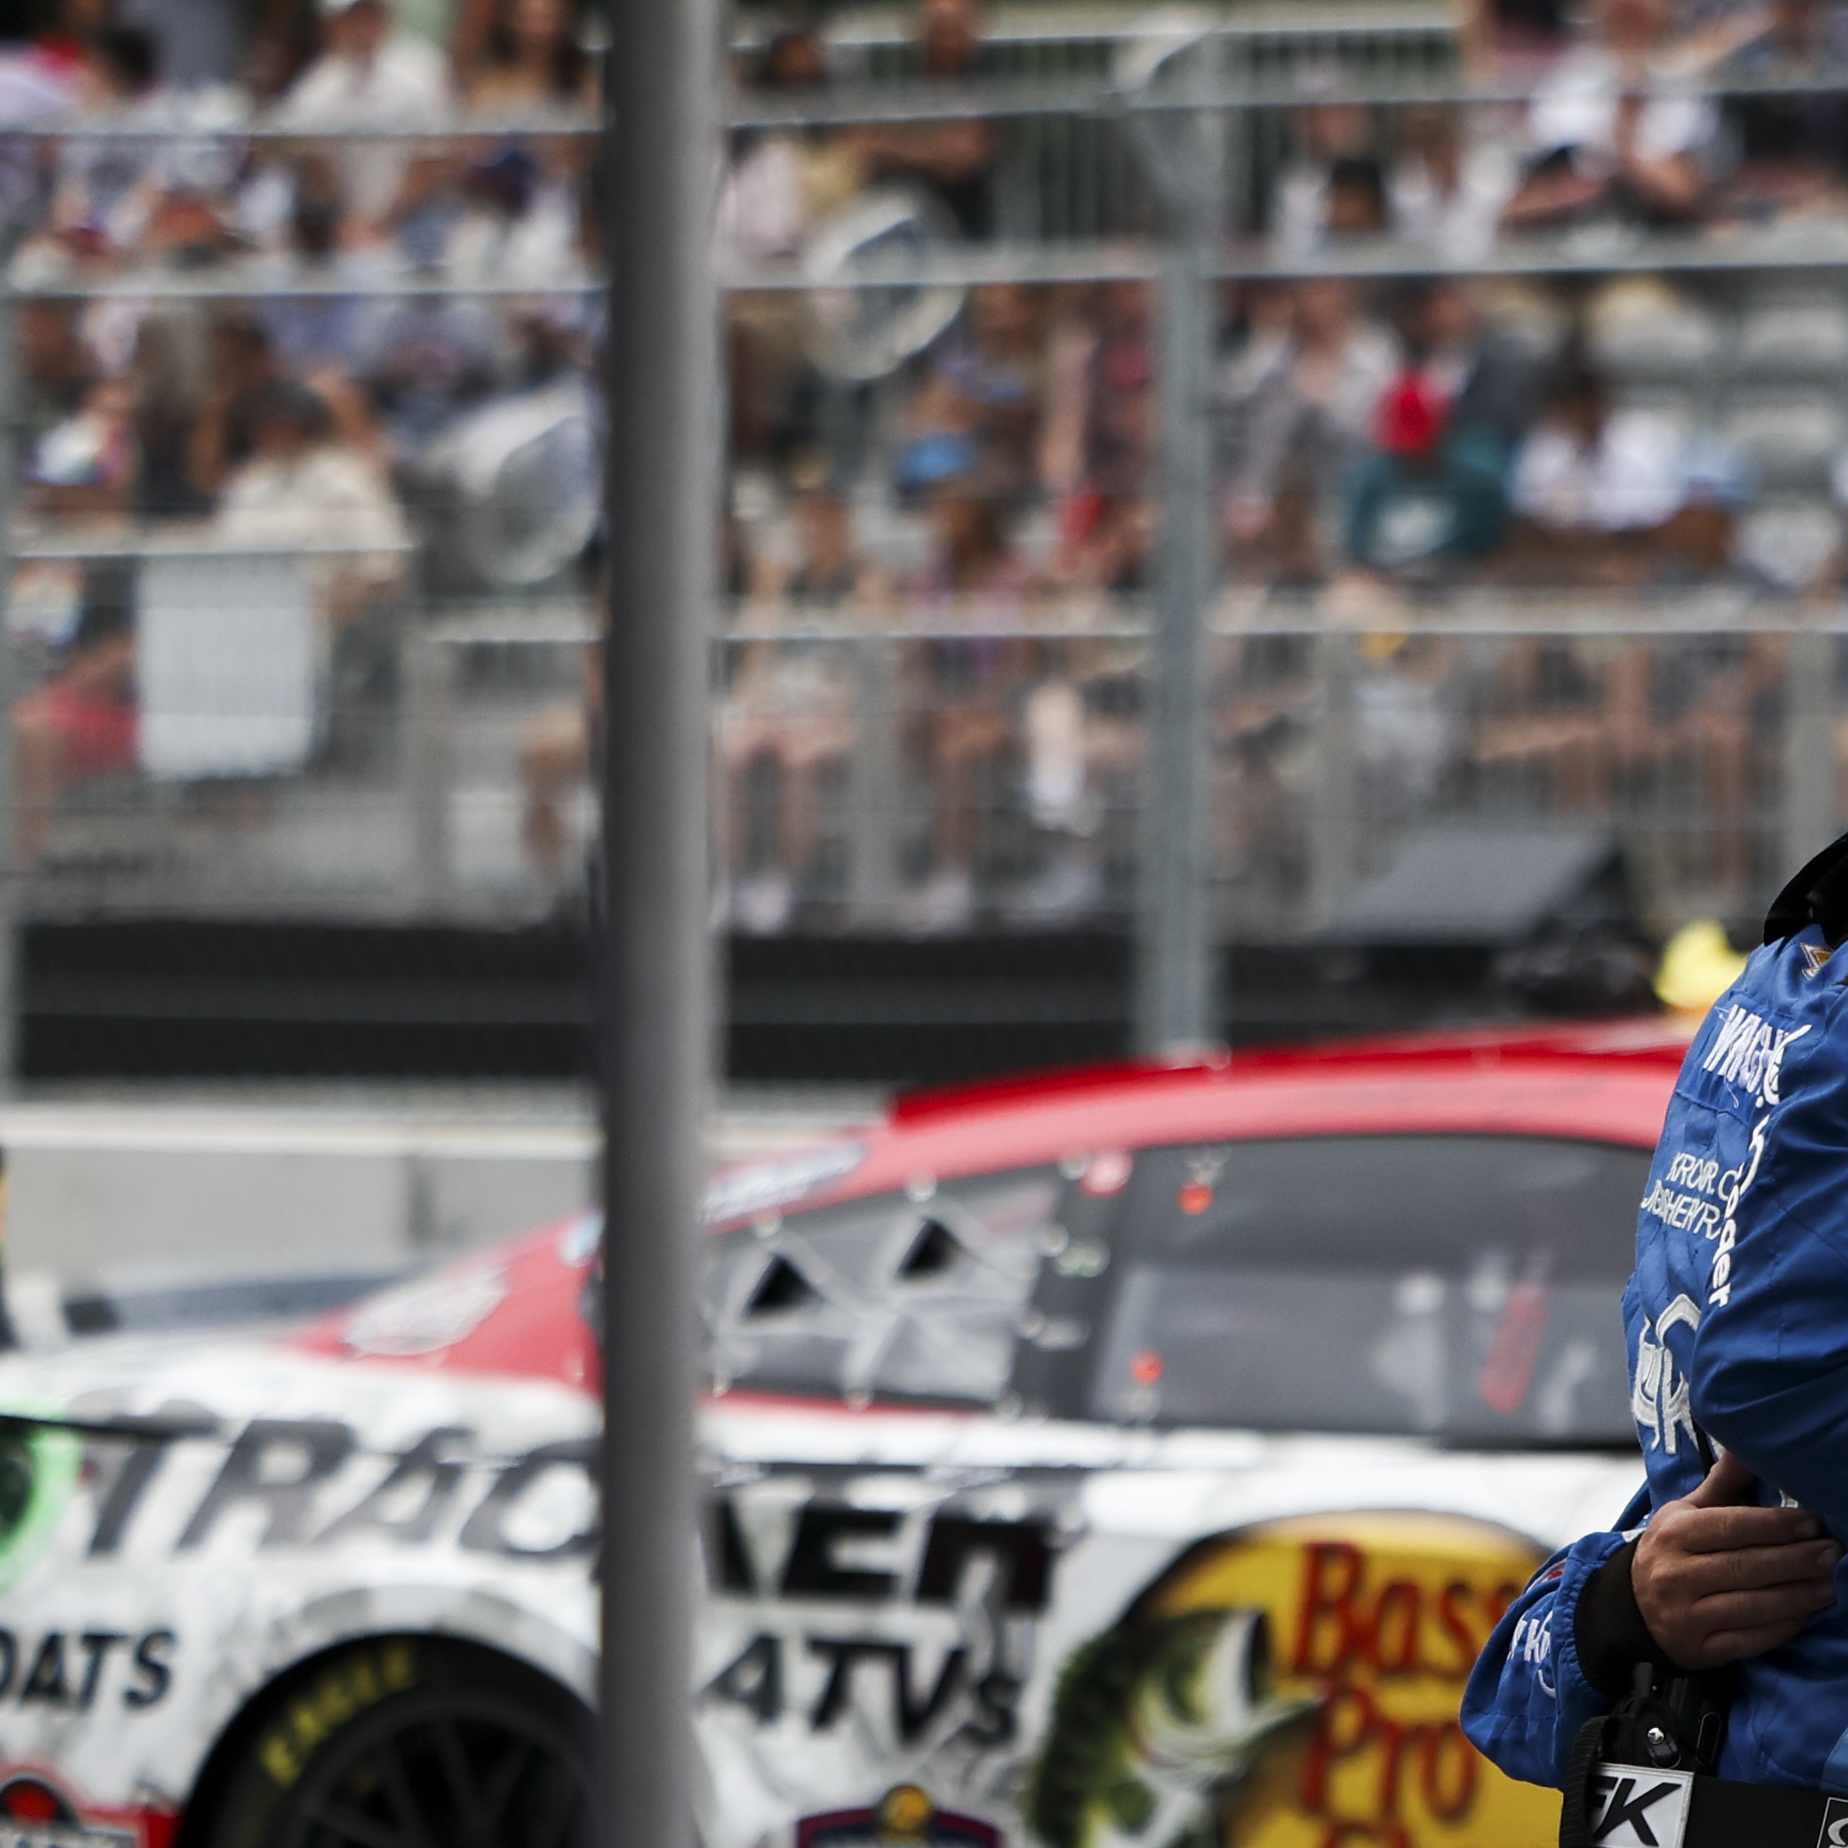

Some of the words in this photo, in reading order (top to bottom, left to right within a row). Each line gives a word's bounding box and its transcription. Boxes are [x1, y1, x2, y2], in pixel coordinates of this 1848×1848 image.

[1708, 1114, 1769, 1308] Koger
[85, 1415, 1055, 1615] TRACER
[0, 1627, 178, 1710] ATS
[1293, 1538, 1515, 1682] Bas
[1303, 1685, 1482, 1825] Pro
